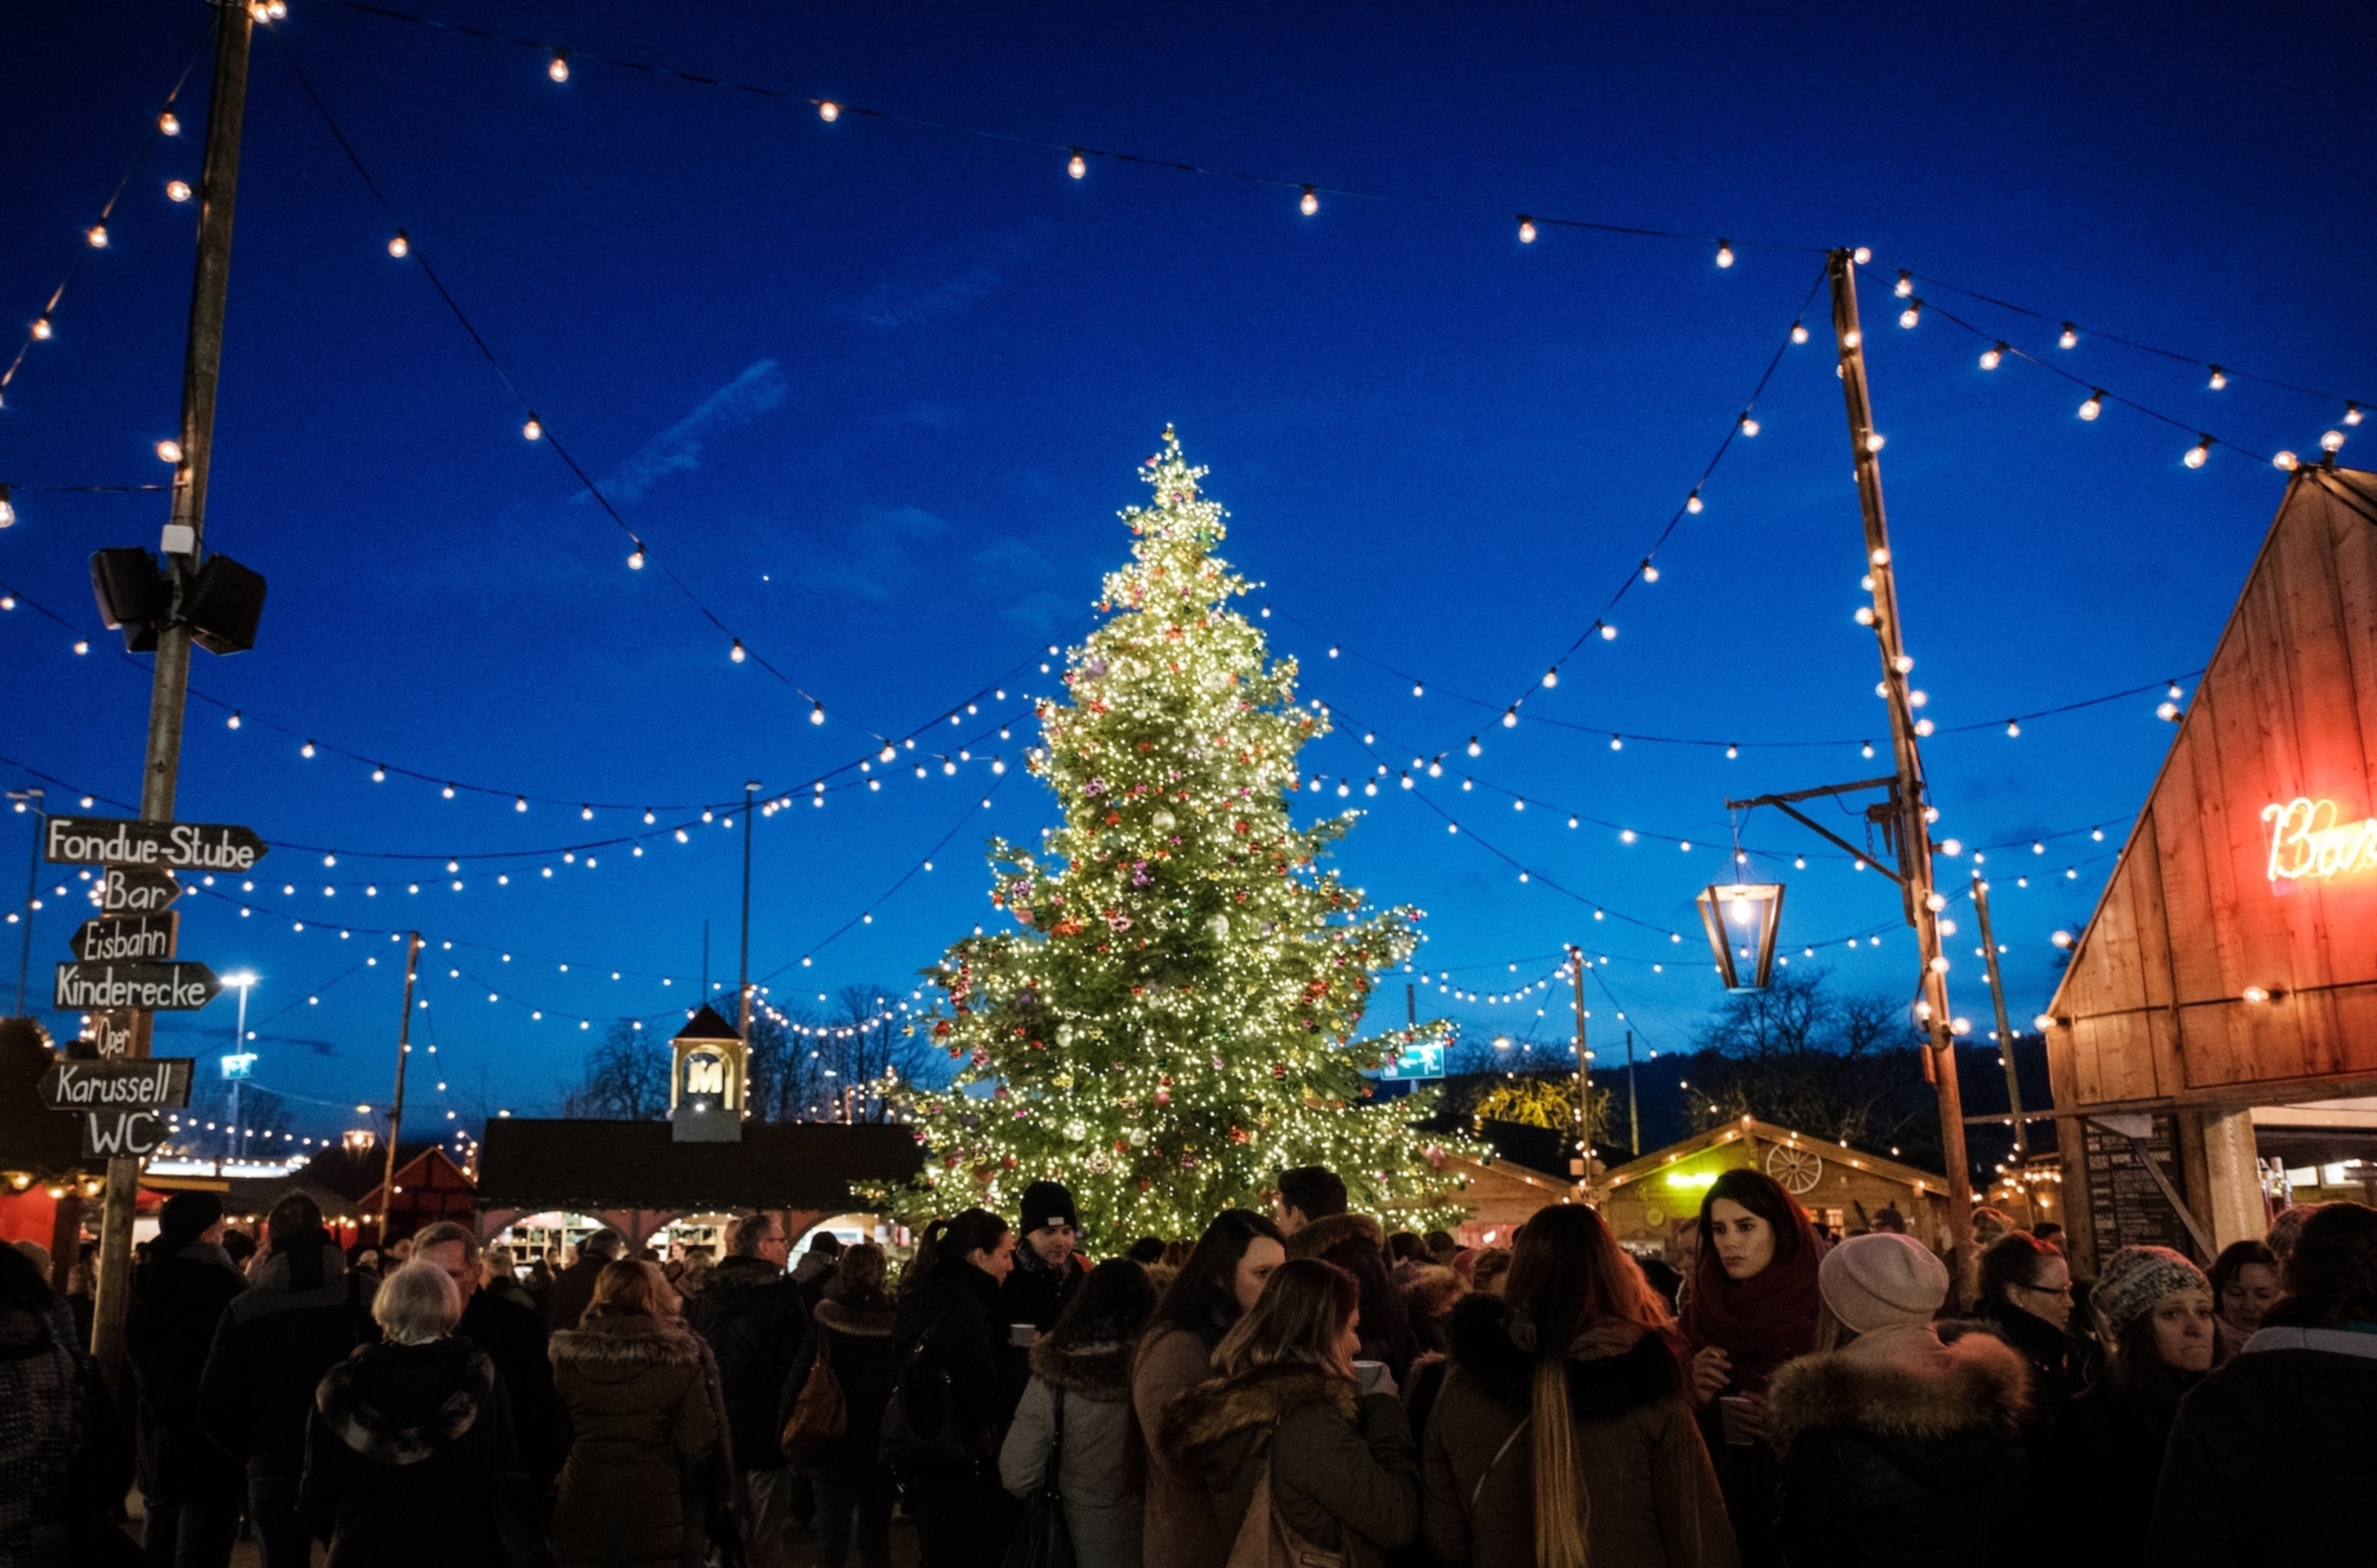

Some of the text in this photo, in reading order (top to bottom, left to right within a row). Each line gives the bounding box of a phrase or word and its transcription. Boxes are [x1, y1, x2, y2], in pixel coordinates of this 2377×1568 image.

[49, 820, 255, 868] Fondue-Stube
[104, 870, 167, 909] Bar
[84, 916, 167, 961] Eisbahn
[56, 965, 206, 1006] Kinderecke
[98, 1017, 130, 1059] Oper
[56, 1063, 171, 1103] Karussell
[89, 1113, 154, 1153] WC
[1579, 1188, 1600, 1200] WC
